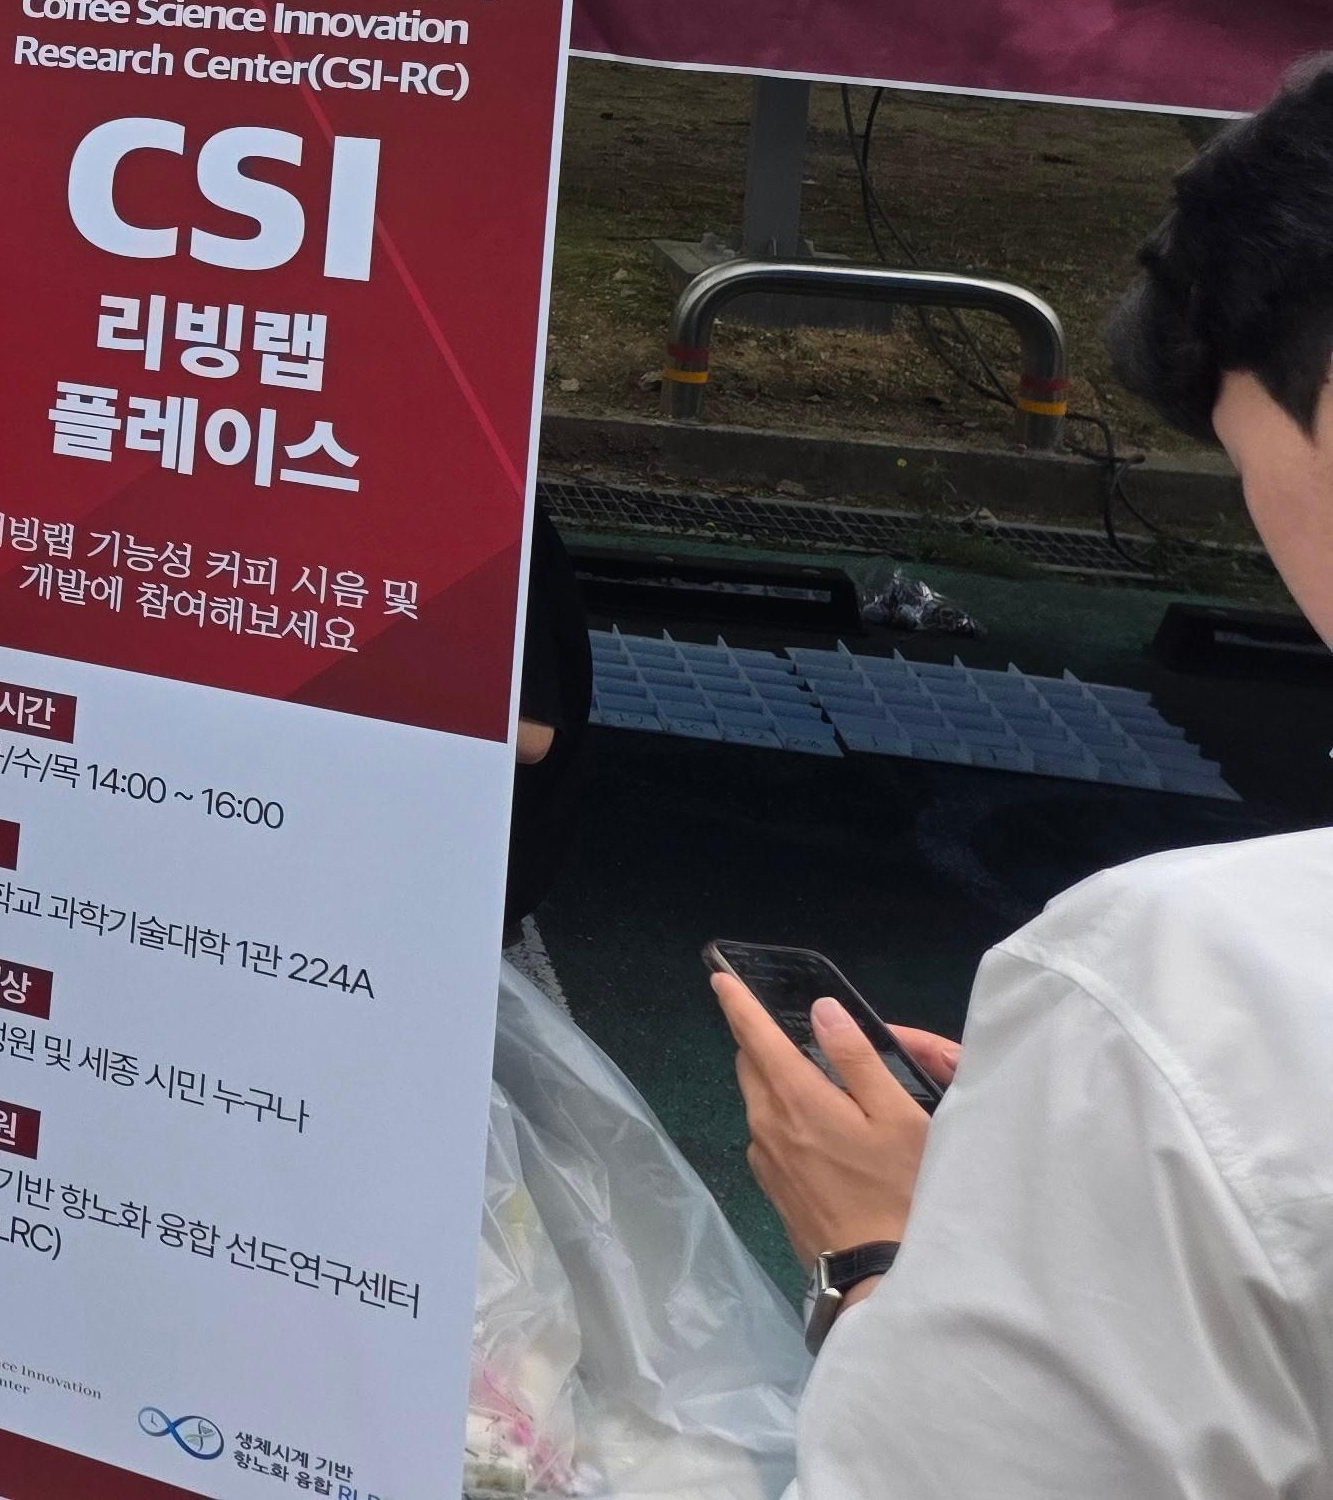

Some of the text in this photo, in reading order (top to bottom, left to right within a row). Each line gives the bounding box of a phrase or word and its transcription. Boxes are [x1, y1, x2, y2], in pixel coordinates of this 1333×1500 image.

[14, 36, 471, 100] Research Center(CSI-RC)
[273, 2, 470, 45] Innovation
[67, 117, 381, 282] CSI
[96, 294, 327, 392] 리빙랩
[48, 381, 360, 492] 플레이스
[19, 563, 359, 653] 개발에 참여해보세요
[87, 530, 192, 578] 기능성
[206, 550, 278, 595] 커피
[292, 565, 369, 609] 시음
[382, 579, 419, 620] 및
[87, 763, 167, 804] 14:00
[200, 787, 284, 830] 16:00
[48, 895, 230, 966] 과학기술대학
[235, 938, 282, 980] 1관
[288, 951, 375, 1000] 224A
[44, 1035, 72, 1072] 및
[79, 1044, 139, 1087] 세종
[145, 1061, 206, 1105] 시민
[213, 1078, 310, 1134] 누구나
[60, 1183, 151, 1239] 항노화
[156, 1208, 220, 1258] 융합
[225, 1231, 421, 1318] 선도연구센터
[21, 1364, 102, 1400] Innovation
[234, 1449, 289, 1482] 항노화
[295, 1471, 333, 1496] 융합
[235, 1431, 353, 1483] 생체시계 기반
